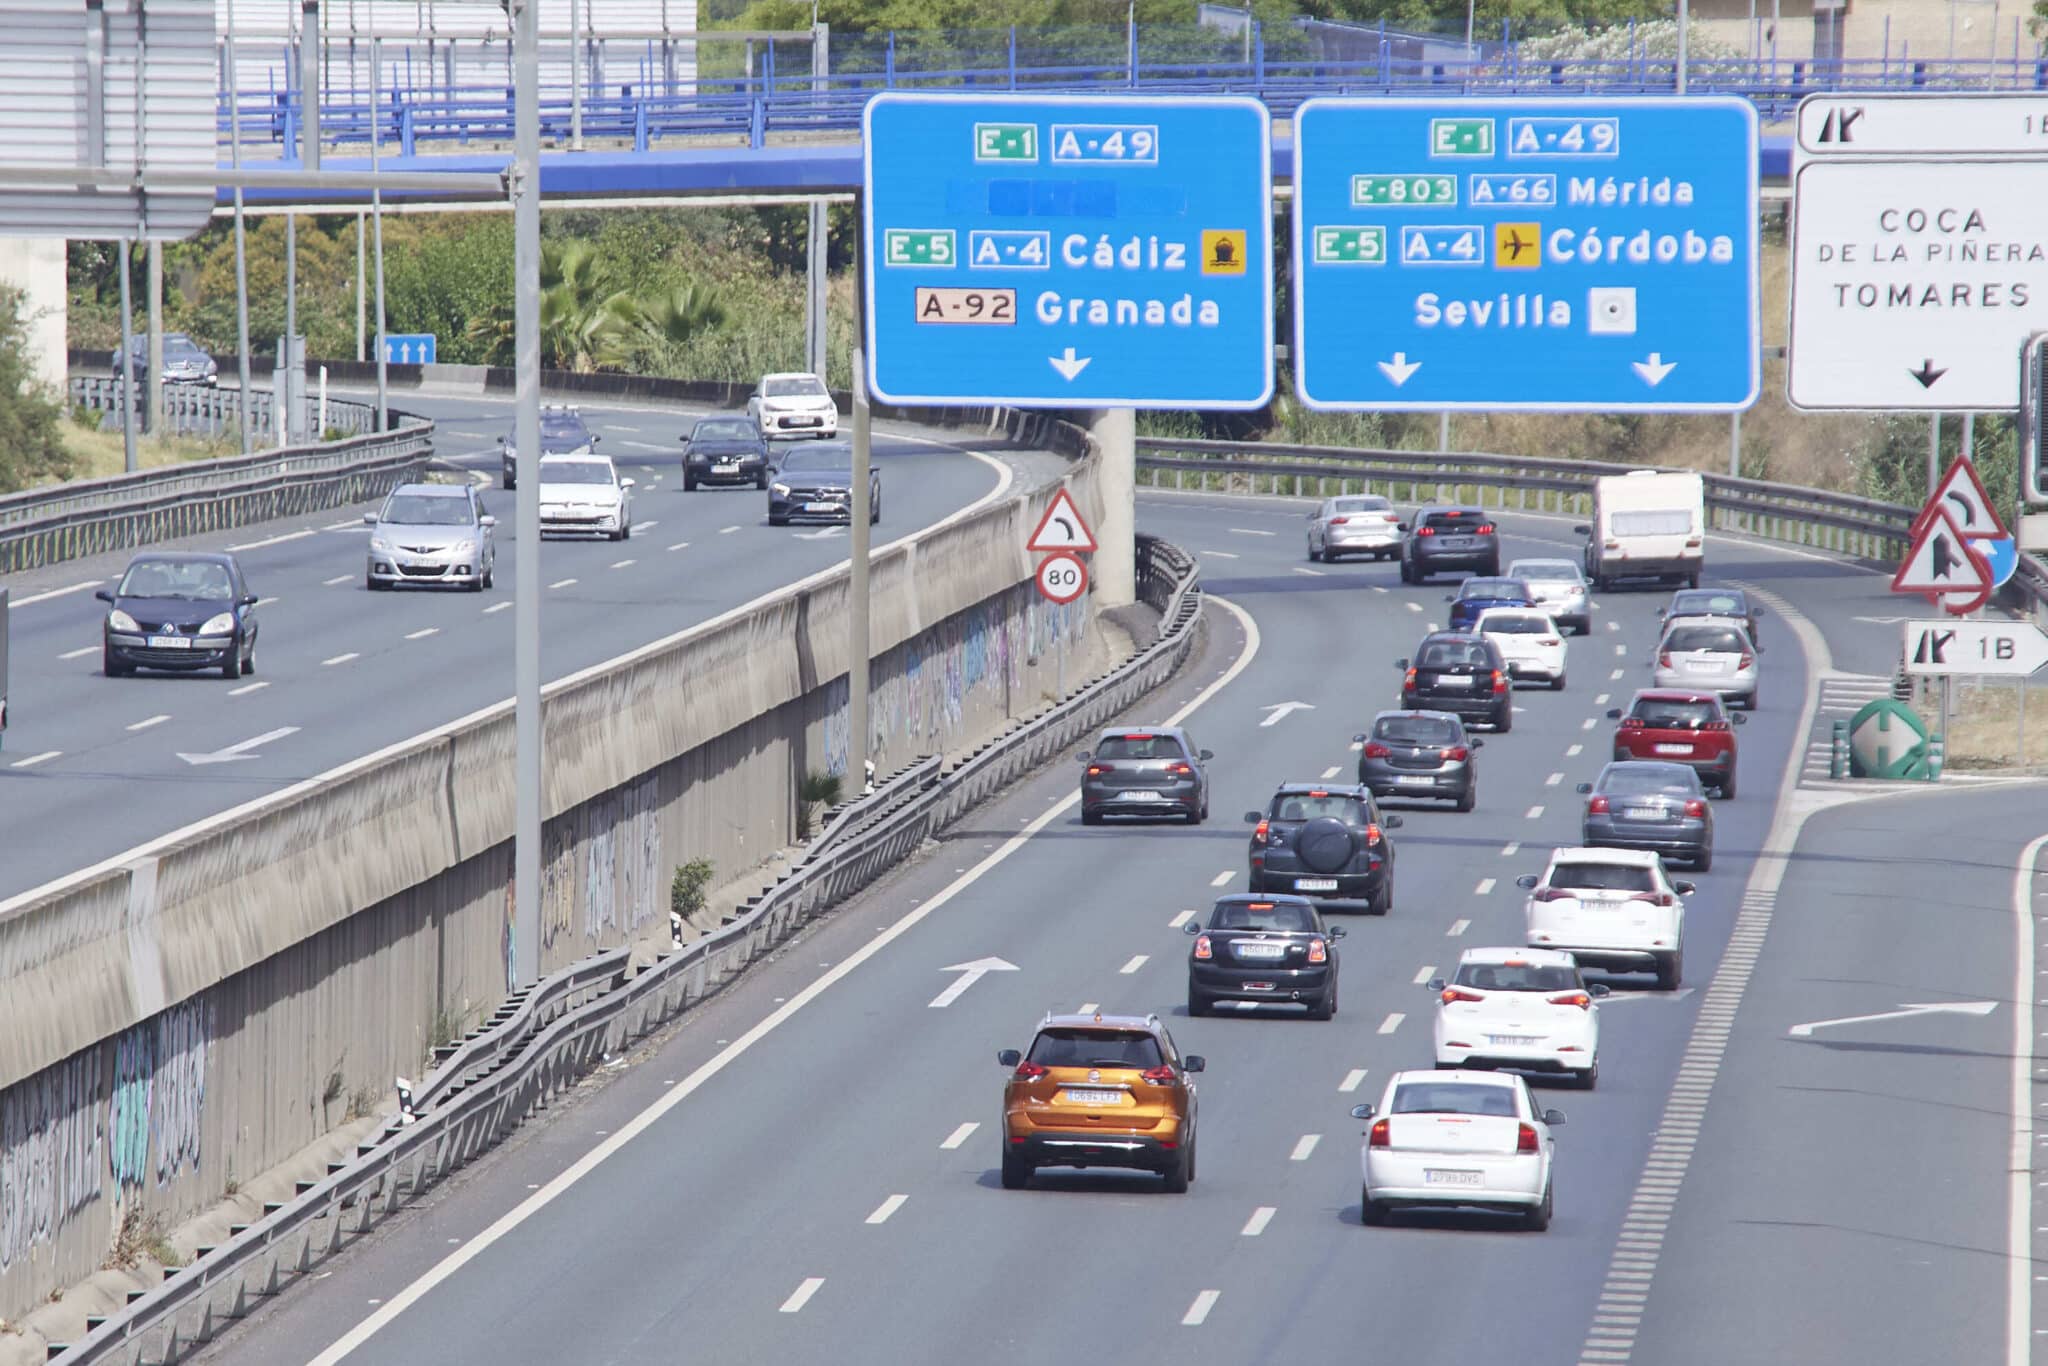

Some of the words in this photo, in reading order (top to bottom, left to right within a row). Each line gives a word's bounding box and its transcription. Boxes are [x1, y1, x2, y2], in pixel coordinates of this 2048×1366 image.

[981, 129, 1033, 157] E-1
[1058, 131, 1154, 158] A-49
[1435, 123, 1489, 151] E-1
[1514, 123, 1613, 151] A-49
[1356, 178, 1452, 202] E-803
[1474, 178, 1550, 201] A-66
[1567, 177, 1694, 205] Mérida
[1880, 208, 1985, 233] COCA
[889, 235, 950, 264] E-5
[976, 236, 1043, 265] A-4
[1062, 234, 1185, 269] Cádiz
[1319, 231, 1381, 259] E-5
[1406, 230, 1478, 259] A-4
[1548, 227, 1733, 263] Córdoba
[1819, 244, 1856, 262] DE
[1873, 244, 1908, 262] LA
[1927, 240, 2045, 262] PIÑERA
[922, 294, 1011, 318] A-92
[1036, 291, 1220, 326] Granada
[1834, 283, 2029, 307] TOMARES
[1415, 293, 1570, 327] Sevilla
[1048, 569, 1077, 586] 80
[1979, 636, 2016, 660] 1B
